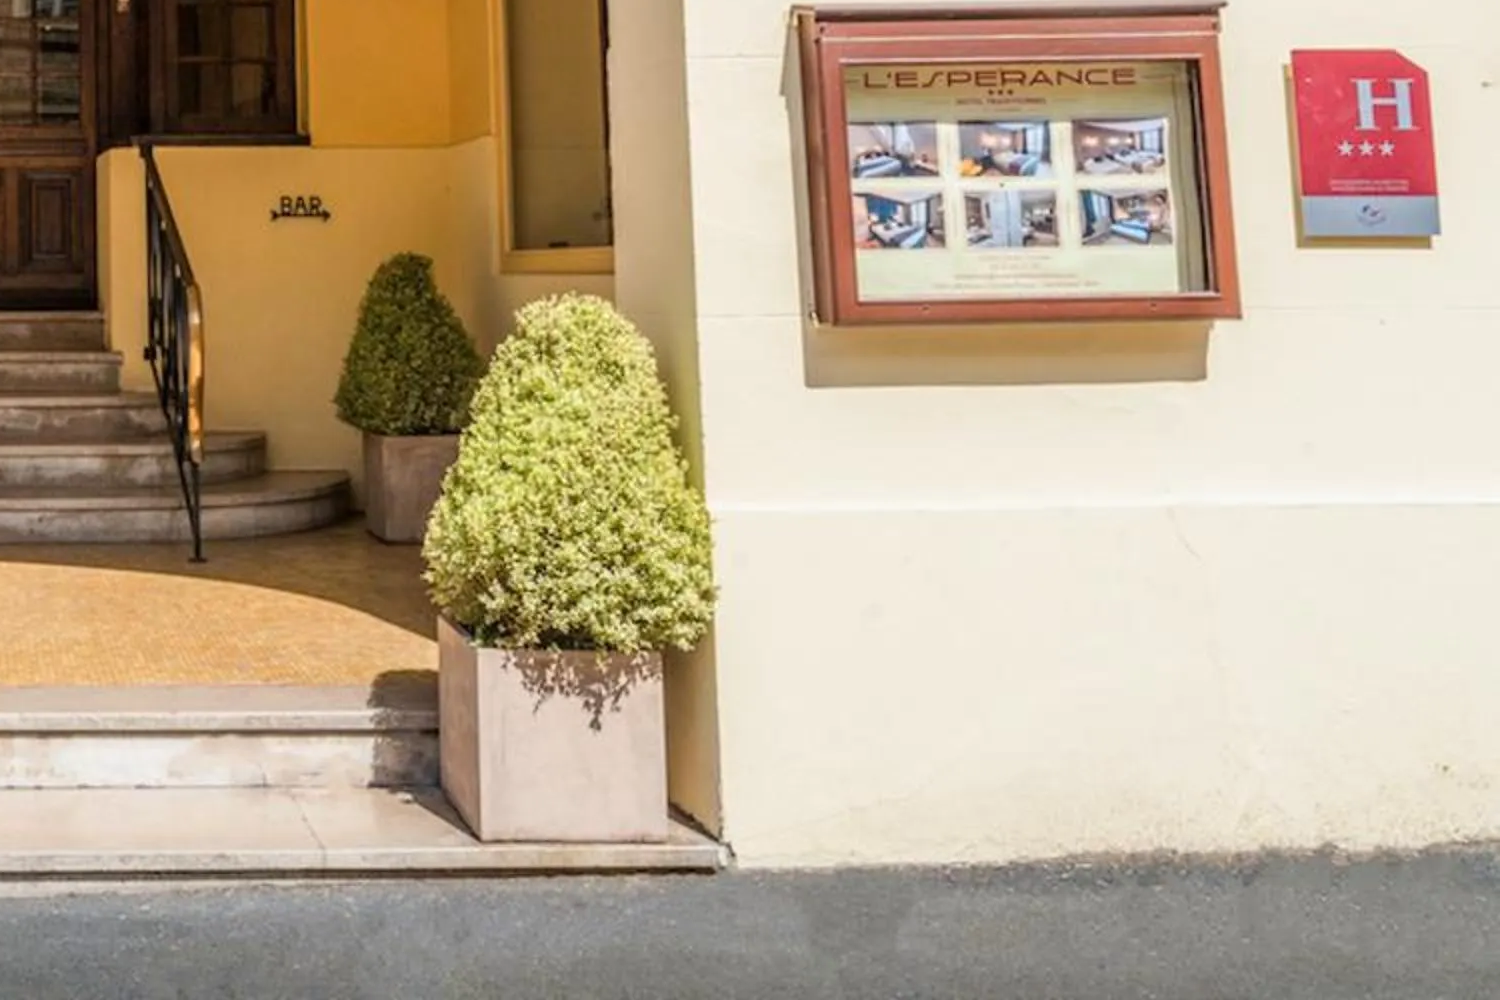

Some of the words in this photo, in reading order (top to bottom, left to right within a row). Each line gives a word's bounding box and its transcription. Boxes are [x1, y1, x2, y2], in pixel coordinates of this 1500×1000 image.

[863, 68, 1137, 89] L'ESPERANCE
[1349, 77, 1420, 132] H
[280, 195, 323, 217] BAR
